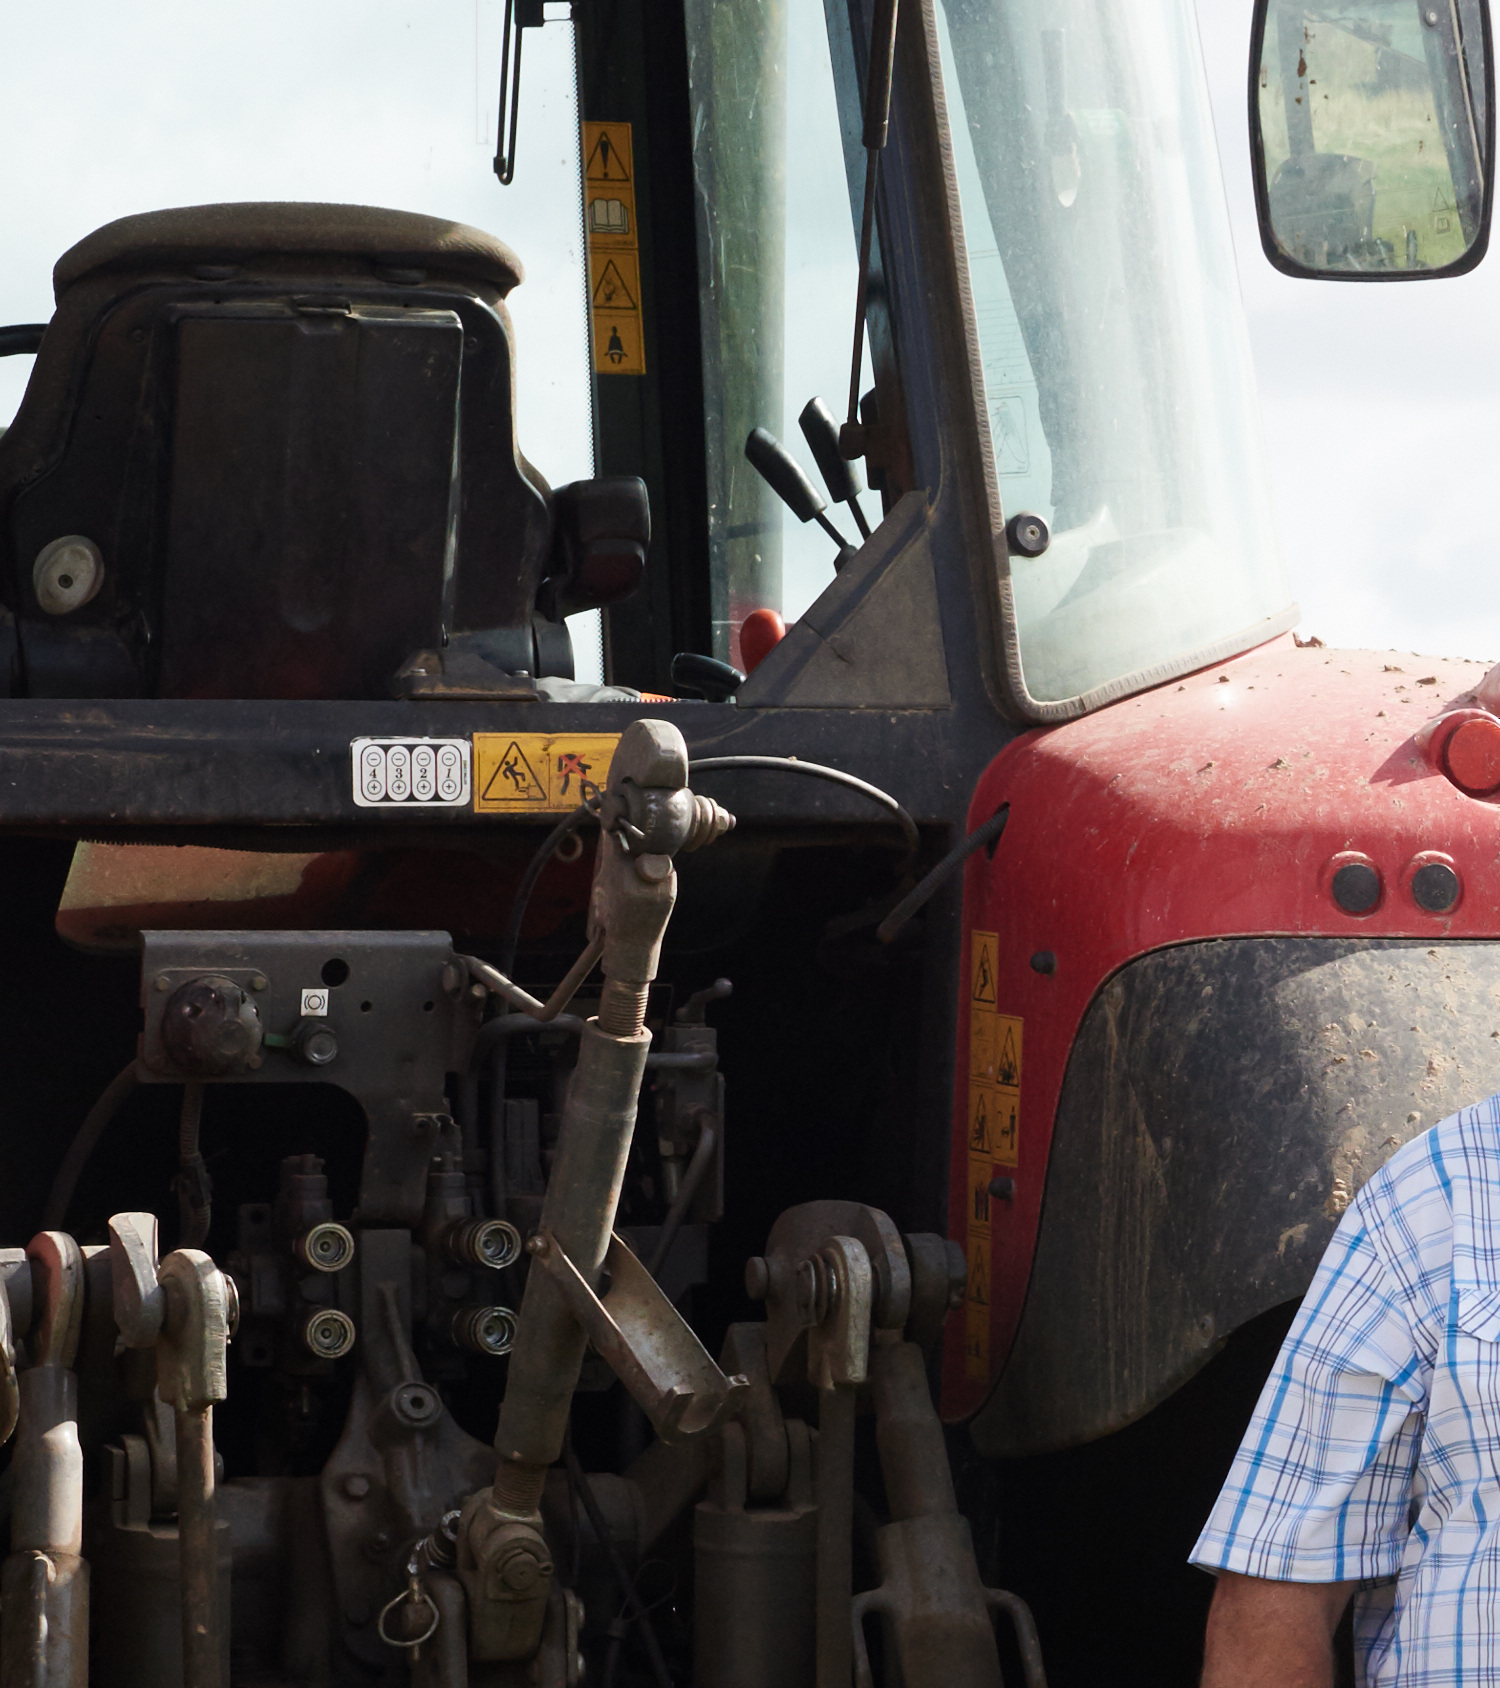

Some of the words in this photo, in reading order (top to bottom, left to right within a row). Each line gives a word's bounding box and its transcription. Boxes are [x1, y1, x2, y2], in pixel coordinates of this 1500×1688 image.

[369, 768, 377, 779] 4
[395, 768, 403, 779] 3
[420, 768, 428, 778] 2
[446, 768, 452, 778] 1
